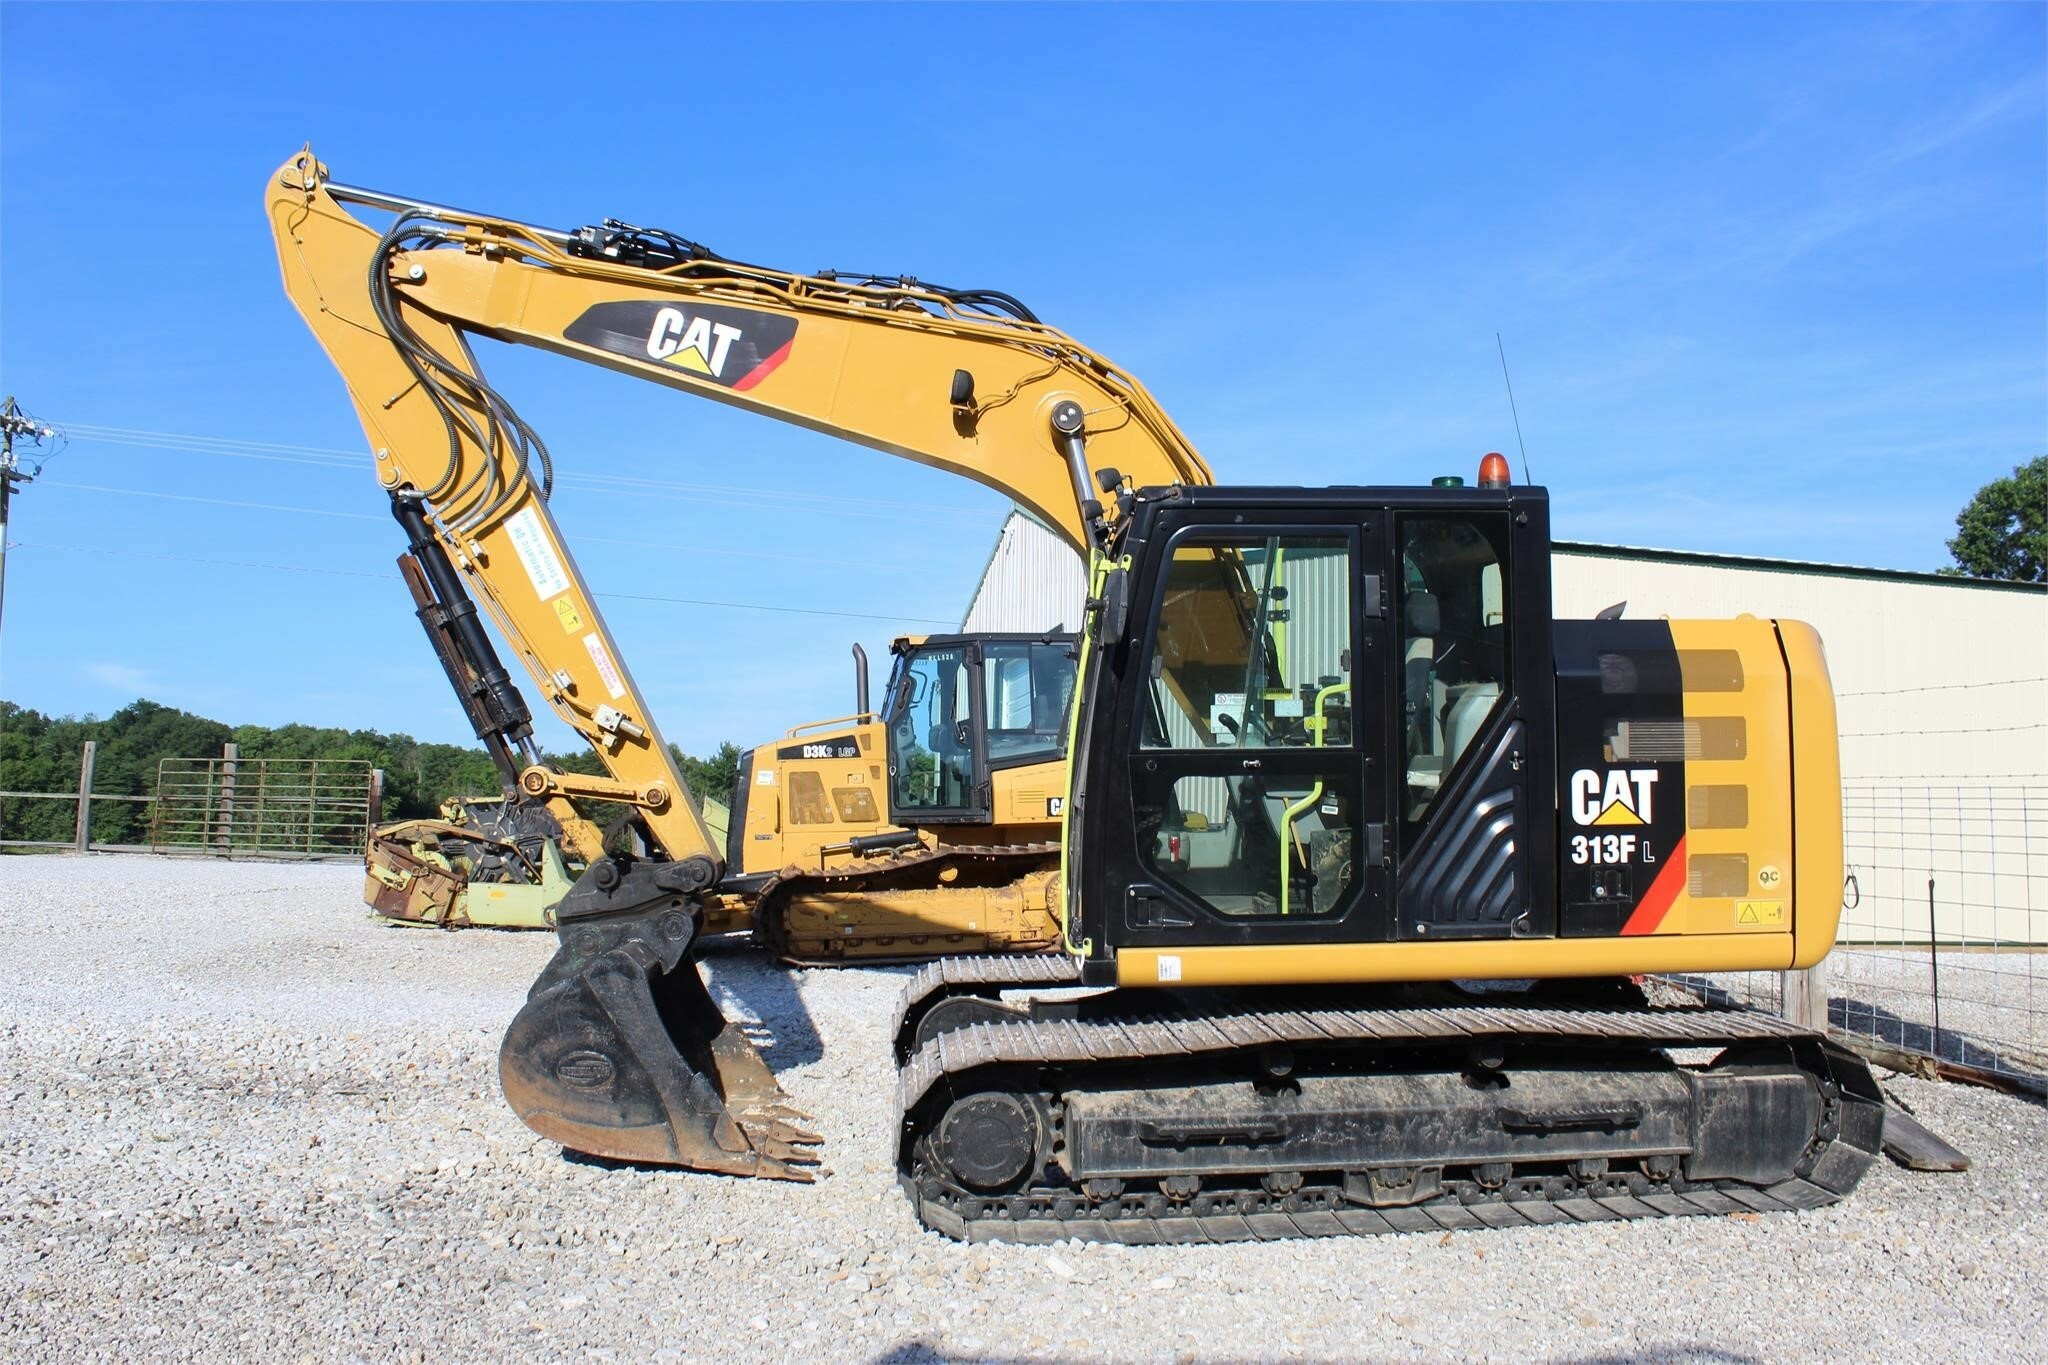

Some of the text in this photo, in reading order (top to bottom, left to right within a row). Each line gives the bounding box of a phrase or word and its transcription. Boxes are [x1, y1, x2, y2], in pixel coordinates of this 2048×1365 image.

[647, 308, 741, 378] CAT
[518, 539, 548, 585] Automatic
[1571, 769, 1658, 826] CAT
[1571, 835, 1655, 864] 313F L
[1759, 871, 1779, 883] QC
